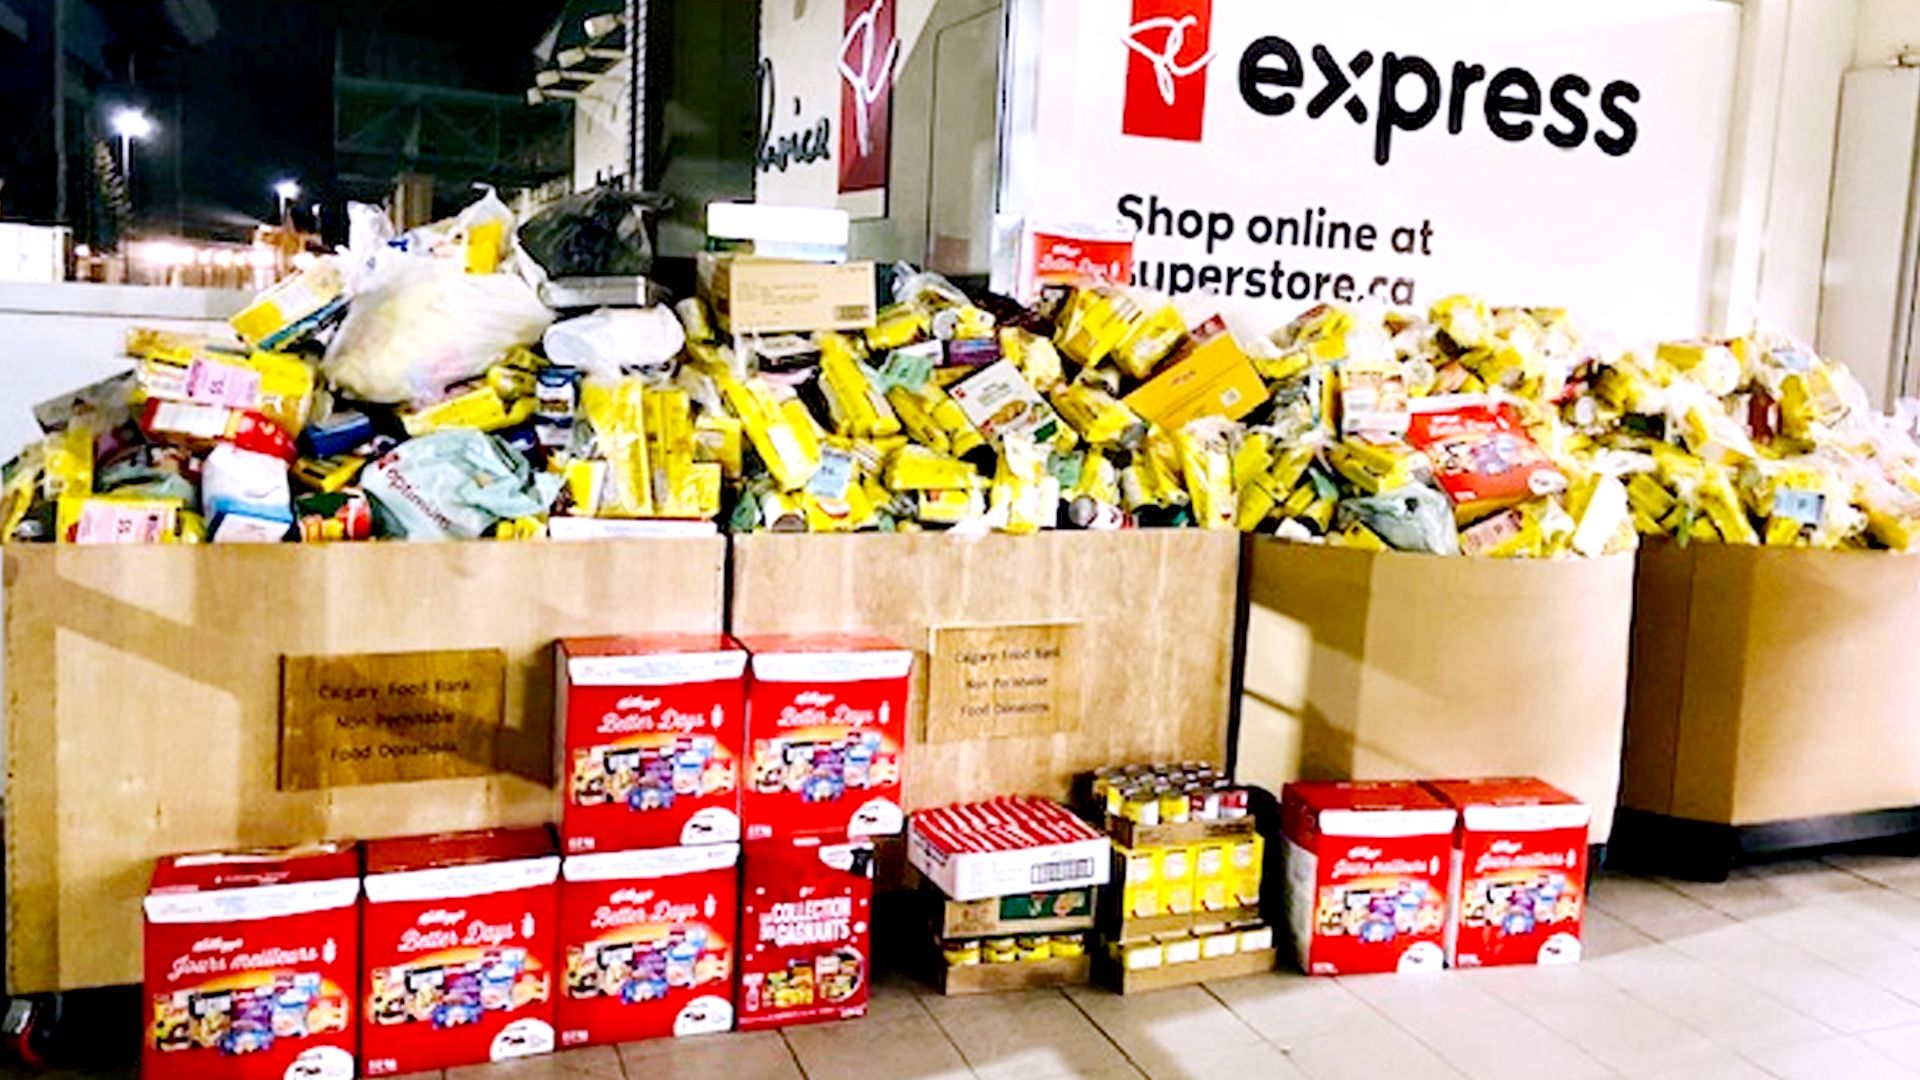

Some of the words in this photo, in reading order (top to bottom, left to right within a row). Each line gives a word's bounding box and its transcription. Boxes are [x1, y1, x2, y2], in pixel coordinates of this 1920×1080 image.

[1237, 35, 1641, 166] express
[1117, 193, 1234, 254] Shop
[1247, 208, 1378, 252] online
[1391, 219, 1434, 256] at
[1001, 649, 1030, 661] Food
[318, 682, 380, 702] Calgary
[387, 681, 429, 697] Food
[434, 679, 471, 693] Bank
[336, 714, 368, 729] Non
[597, 711, 655, 733] Better
[656, 707, 706, 734] Days
[776, 705, 827, 727] Better
[828, 703, 875, 728] Days
[960, 703, 990, 717] Food
[329, 745, 371, 762] Food
[590, 904, 648, 929] Better
[649, 899, 699, 925] Days
[396, 927, 460, 952] Better
[461, 918, 516, 946] Days
[166, 953, 227, 982] Jours
[229, 946, 319, 970] meilleurs
